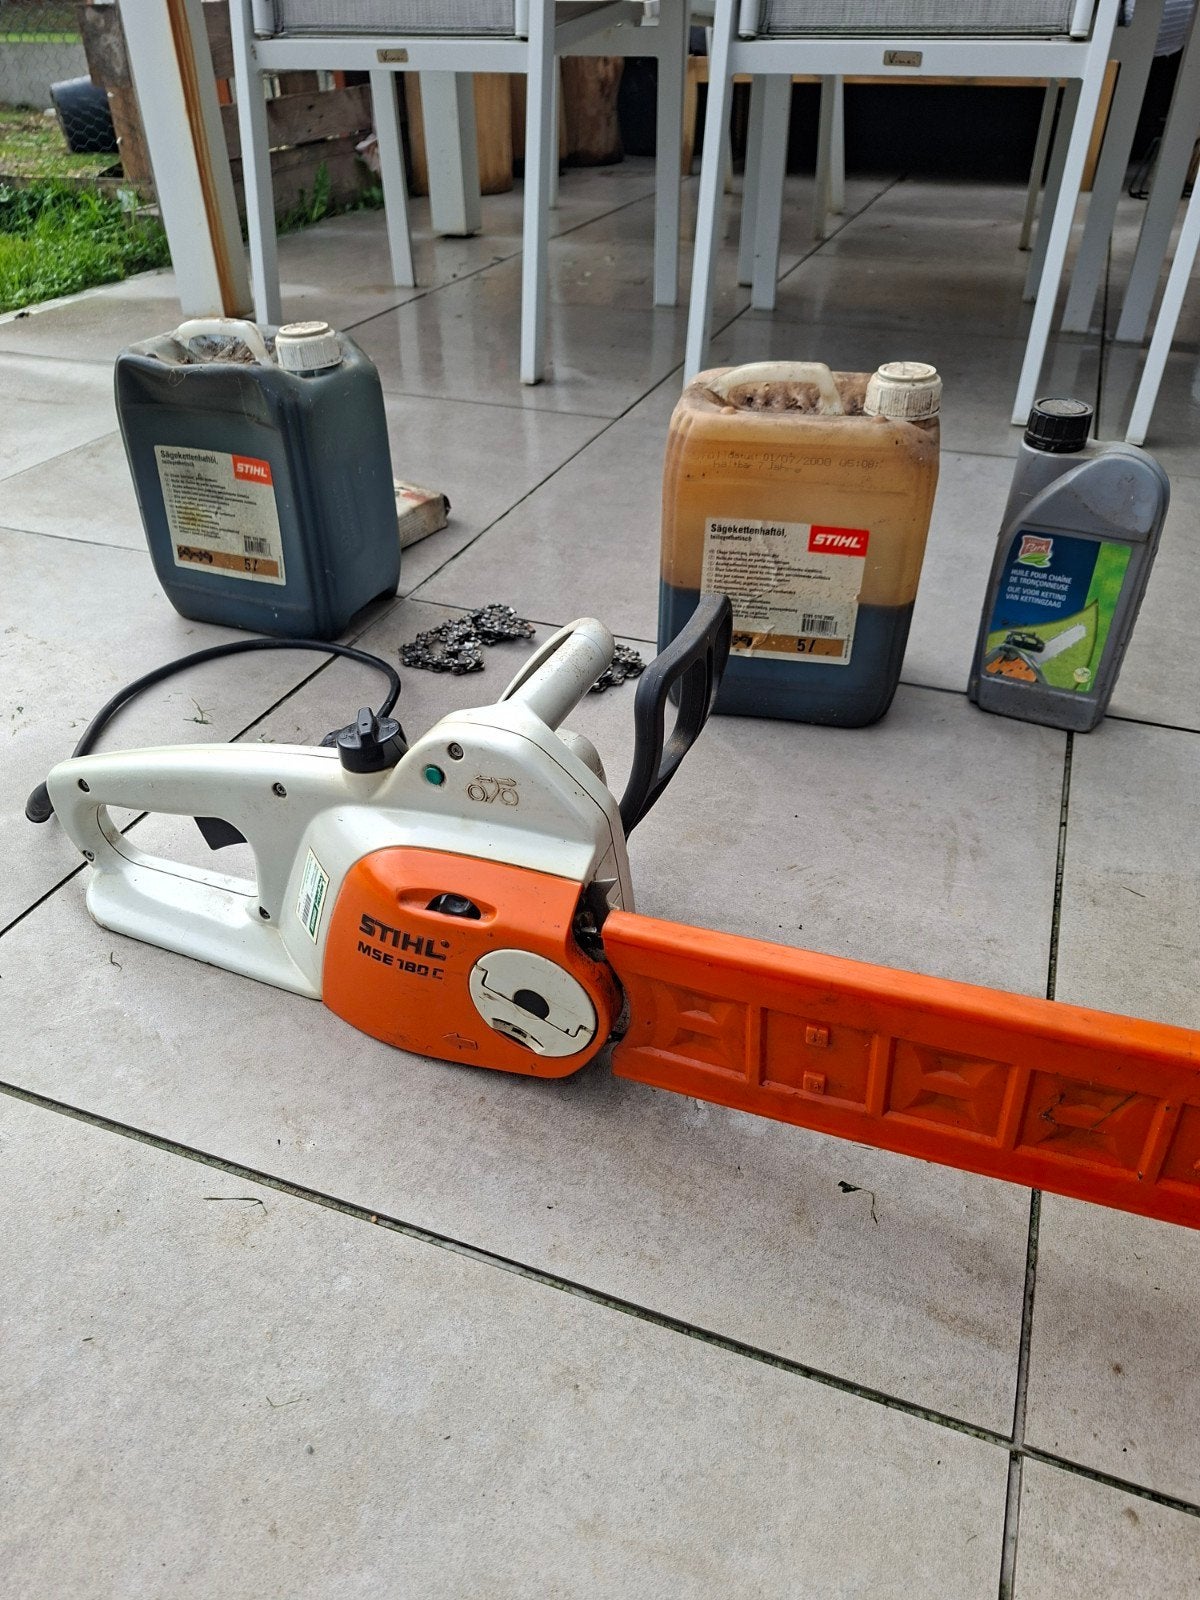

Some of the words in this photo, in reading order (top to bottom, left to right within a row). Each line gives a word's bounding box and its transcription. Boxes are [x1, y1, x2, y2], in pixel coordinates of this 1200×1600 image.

[236, 462, 268, 478] STIHL
[710, 522, 788, 538] Sägekettenhaftöl,
[812, 533, 862, 549] STIHL
[244, 557, 251, 571] 5
[1011, 569, 1030, 577] HUILE
[1030, 571, 1048, 580] POUR
[1048, 574, 1073, 584] CHAÎNE
[1020, 577, 1070, 591] TRONÇONNEUSE
[1005, 593, 1020, 601] VAN
[1022, 588, 1040, 596] VOOR
[1041, 591, 1067, 601] KETTING
[797, 638, 806, 652] 5
[359, 913, 447, 961] STIHL
[357, 940, 394, 966] MSE
[397, 958, 430, 977] 180
[432, 967, 445, 980] C
